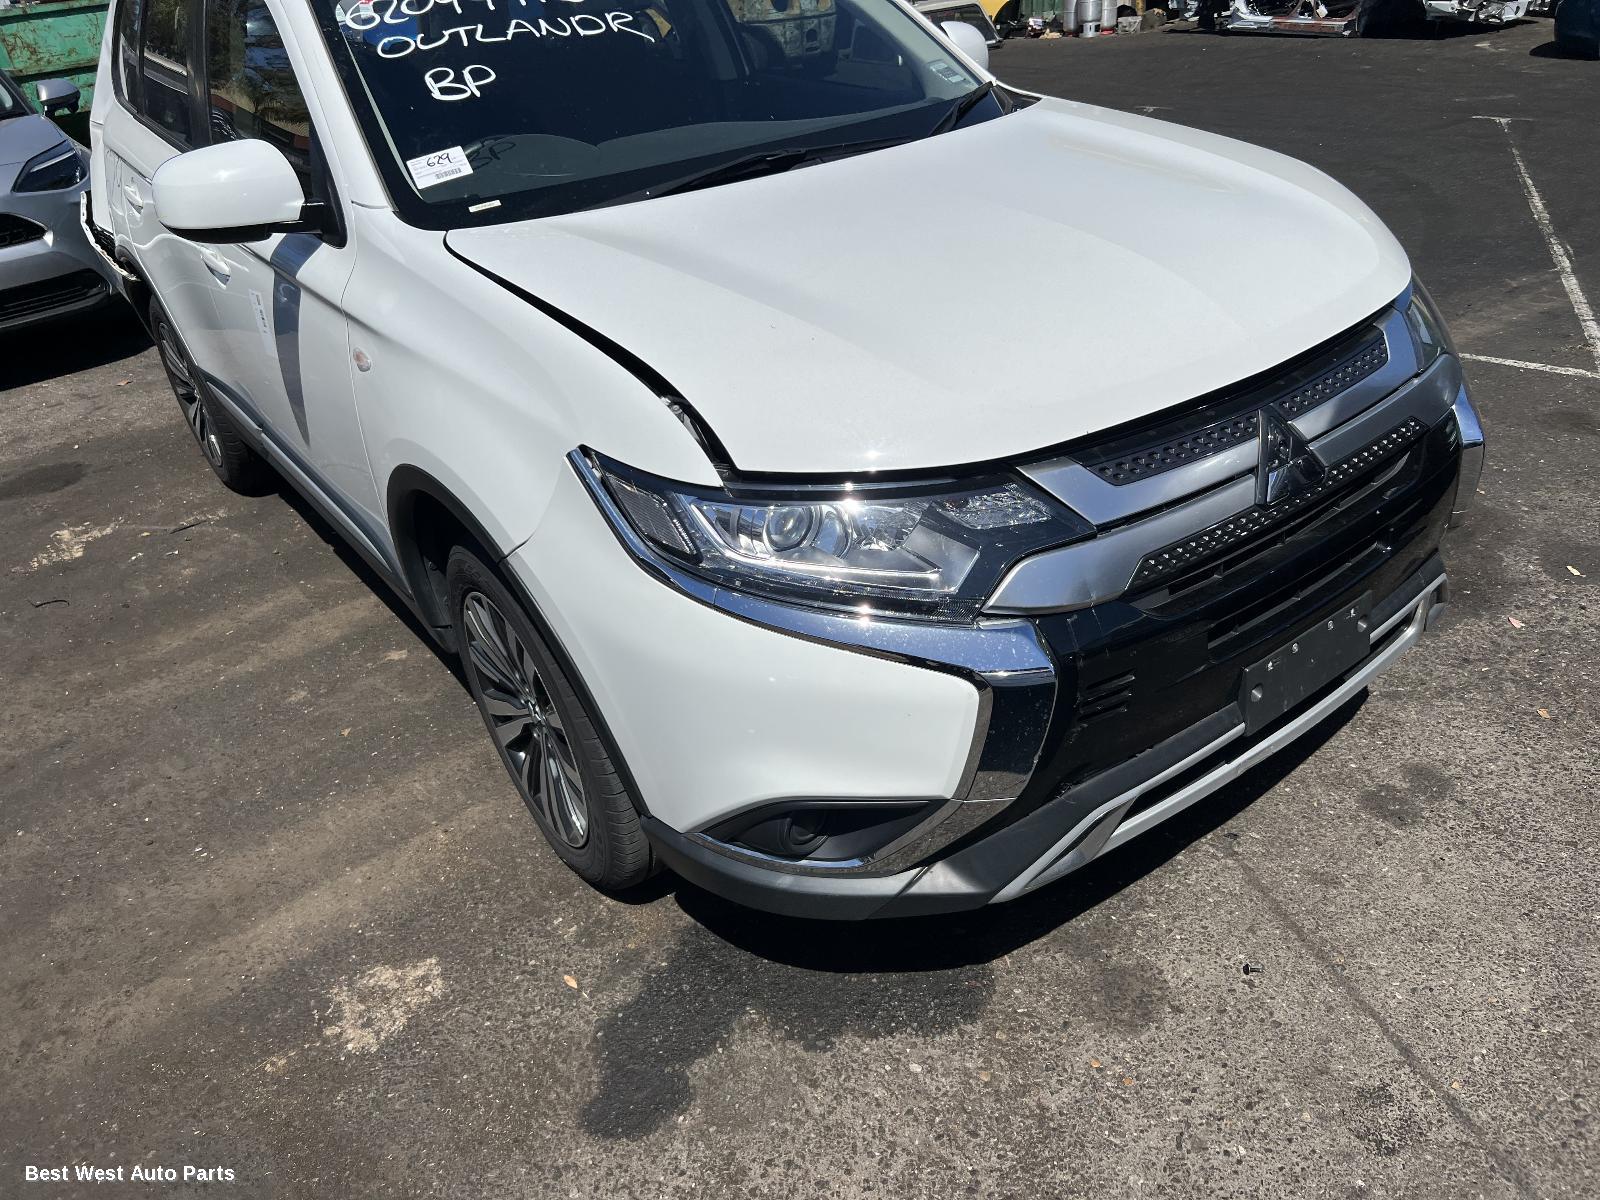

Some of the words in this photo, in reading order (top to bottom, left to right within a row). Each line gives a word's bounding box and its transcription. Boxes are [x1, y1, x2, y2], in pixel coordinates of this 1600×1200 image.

[377, 11, 655, 58] OUTLANDR
[424, 65, 496, 100] BP
[426, 152, 453, 167] 629
